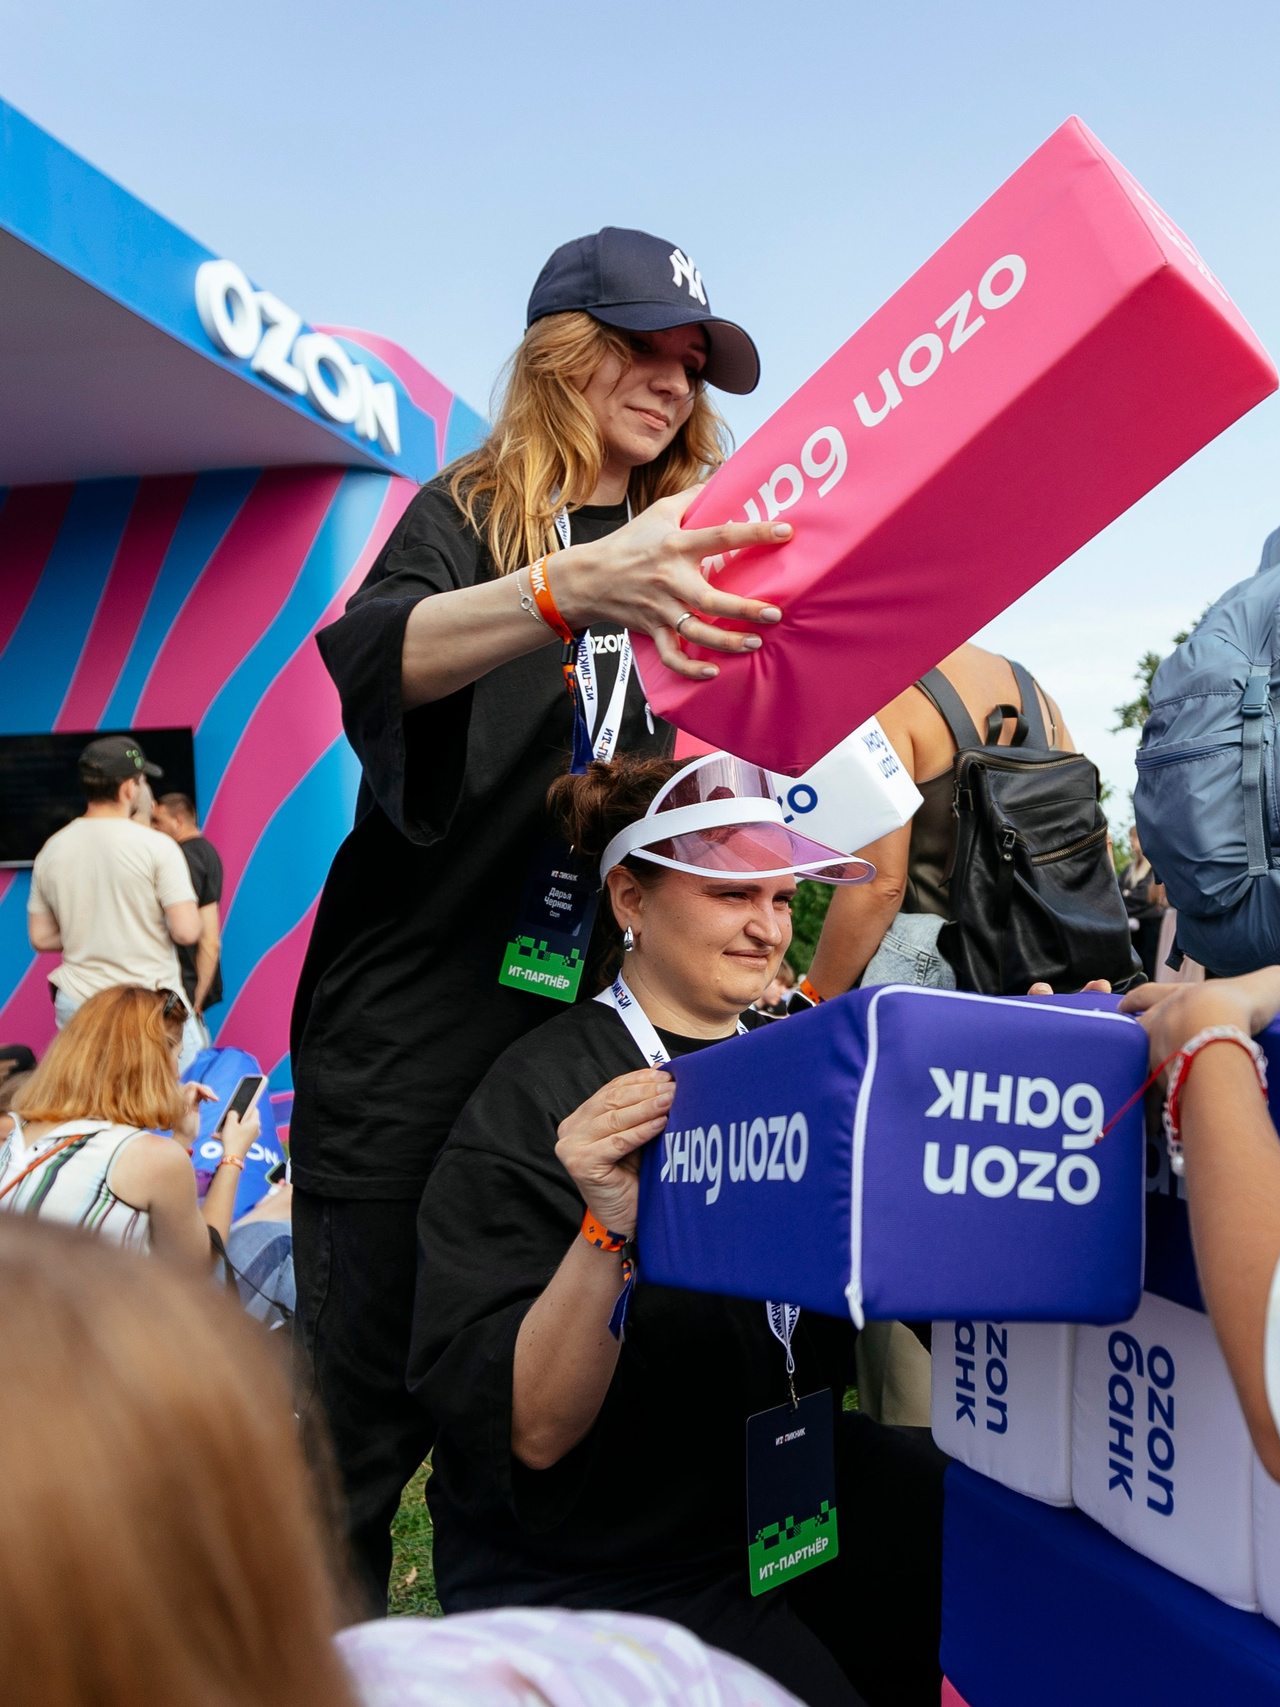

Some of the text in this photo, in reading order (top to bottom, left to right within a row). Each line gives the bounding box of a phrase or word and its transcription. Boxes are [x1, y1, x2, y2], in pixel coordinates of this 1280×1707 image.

[195, 259, 401, 457] OZON
[852, 254, 1027, 428] ozon
[877, 754, 900, 779] ozon
[544, 896, 573, 912] Чернюк
[549, 887, 573, 901] Дарья
[508, 964, 571, 990] ИТ-ПАРТНЁР
[924, 1066, 1106, 1151] банк
[200, 1140, 279, 1167] OON
[660, 1111, 810, 1207] ozon банк
[922, 1141, 1101, 1207] ozon
[954, 1319, 976, 1428] анк
[985, 1320, 1008, 1435] zon
[1107, 1330, 1145, 1503] банк
[1147, 1344, 1176, 1517] ozon
[759, 1536, 829, 1581] ИТ-ПАРТНЁР
